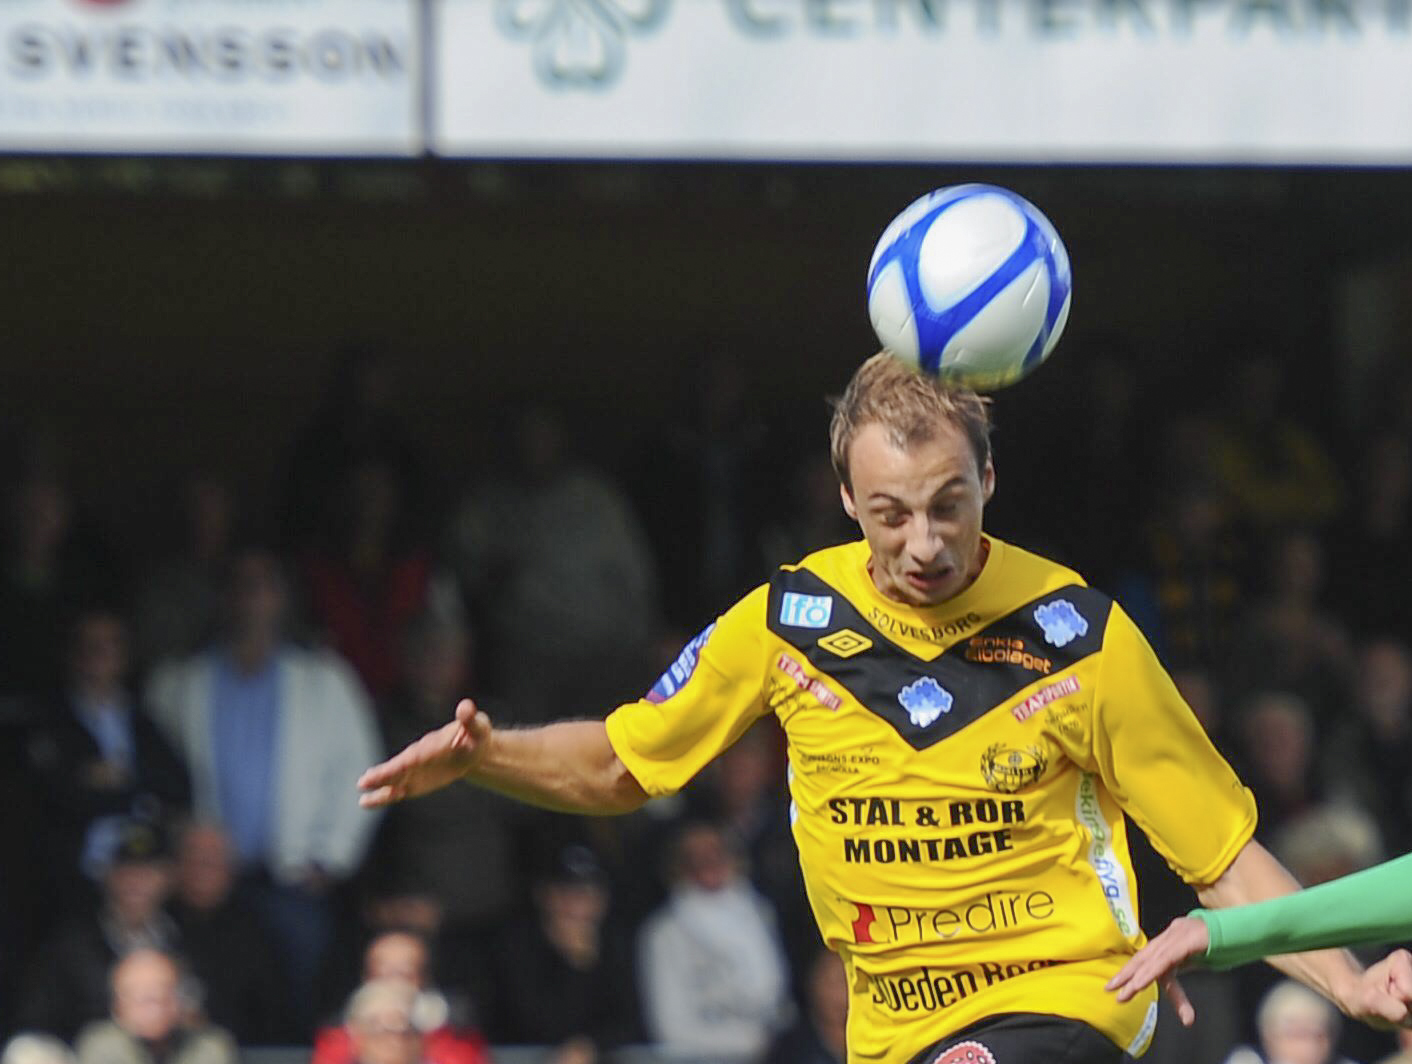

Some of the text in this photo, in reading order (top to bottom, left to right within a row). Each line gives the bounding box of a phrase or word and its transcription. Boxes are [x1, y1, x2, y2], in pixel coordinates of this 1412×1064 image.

[9, 25, 405, 82] SVENSSON
[915, 806, 941, 828] &
[844, 828, 1014, 865] MONTAGE
[886, 888, 1055, 942] Predire
